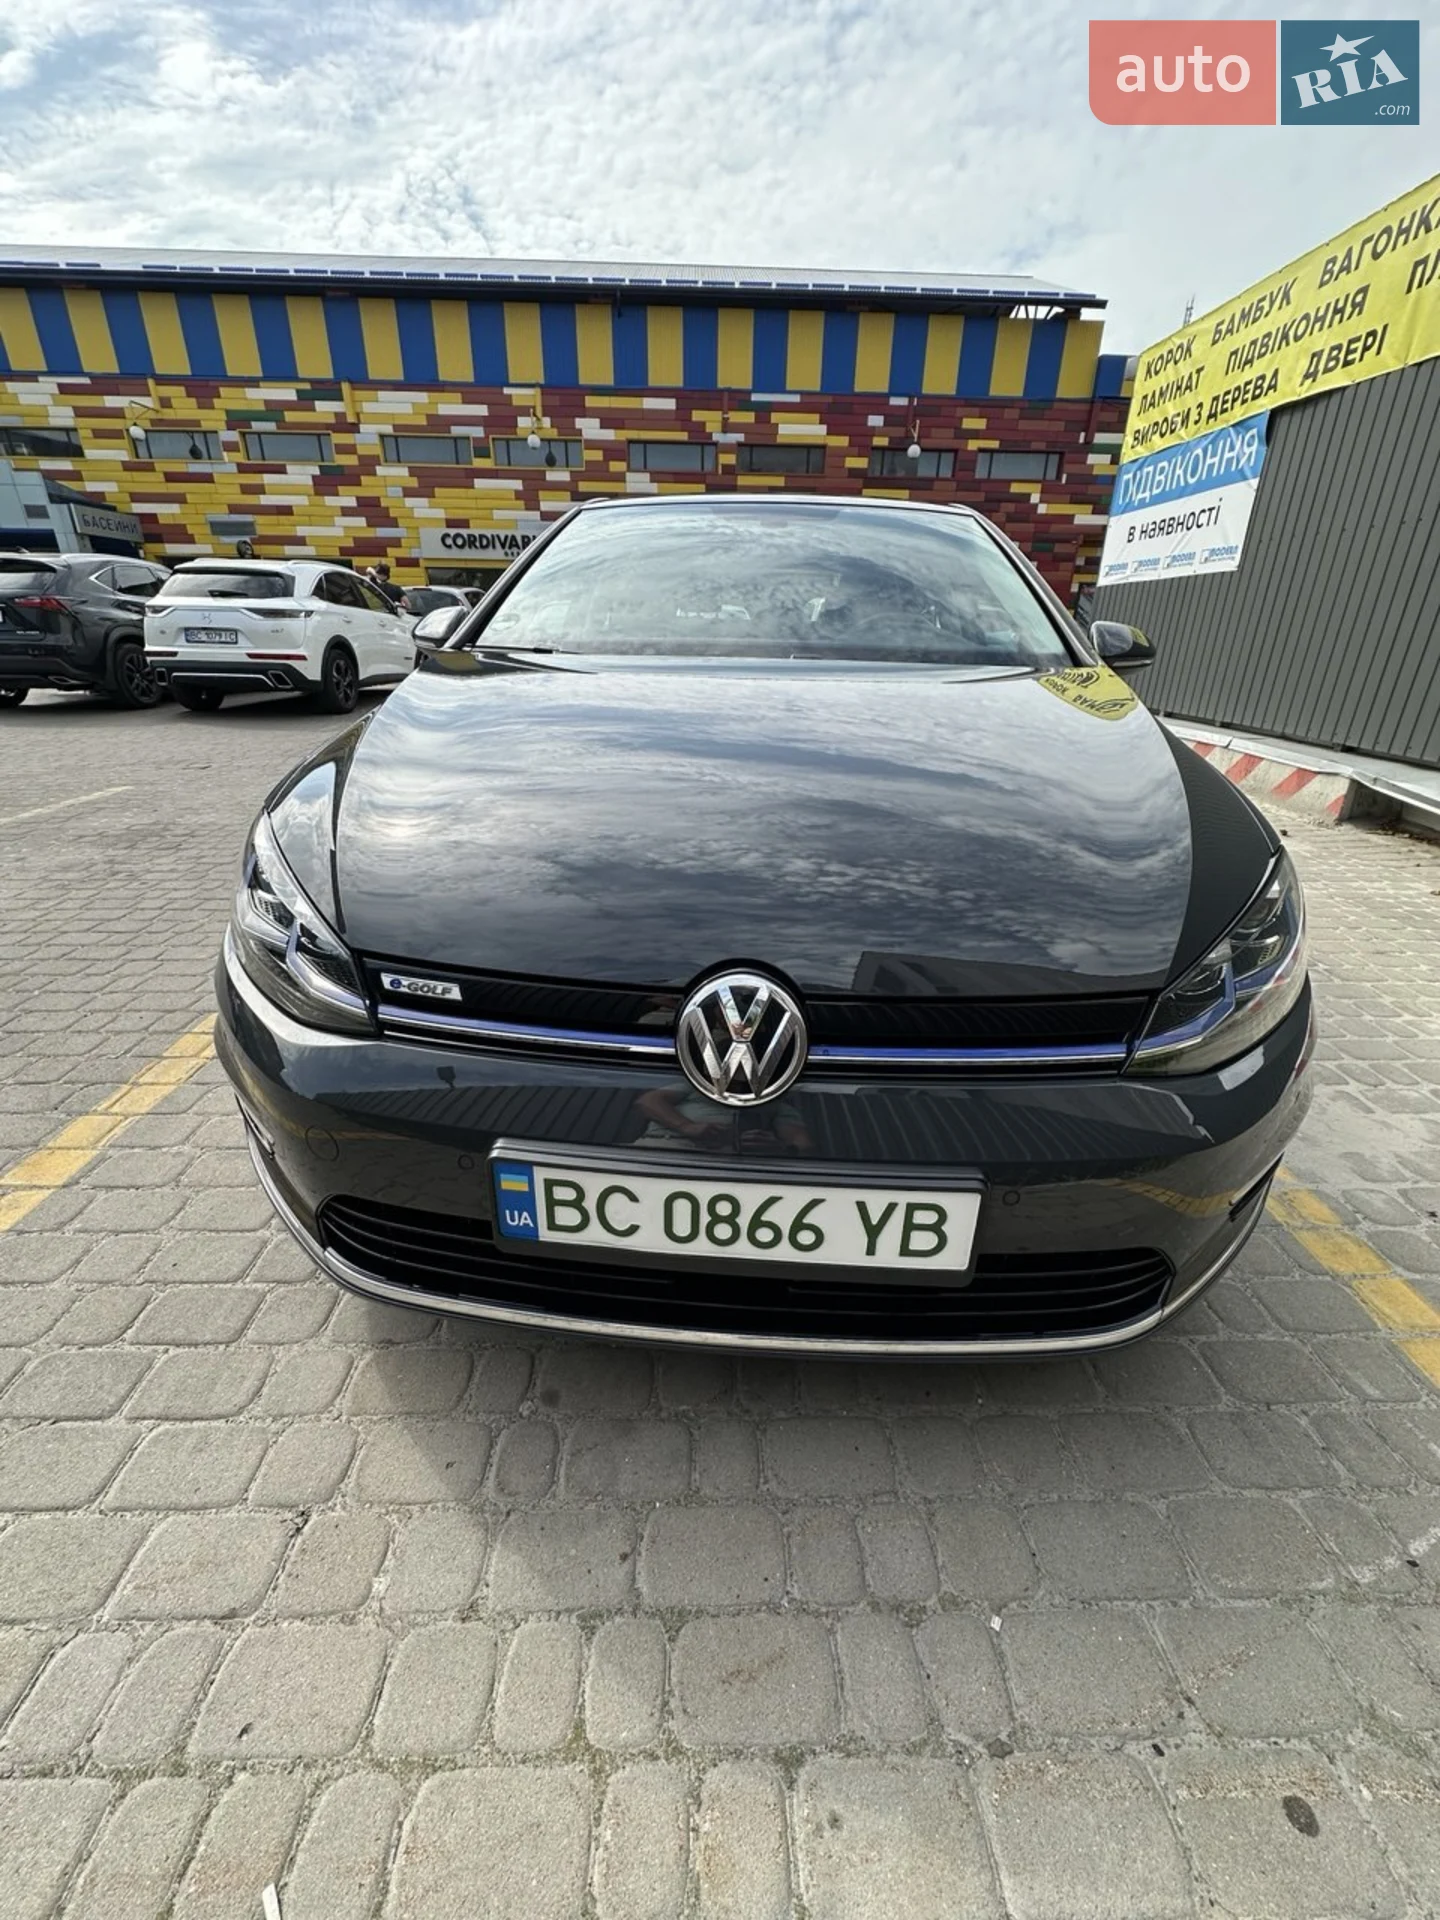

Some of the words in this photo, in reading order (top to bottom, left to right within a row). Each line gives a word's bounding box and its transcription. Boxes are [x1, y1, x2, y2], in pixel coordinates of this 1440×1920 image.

[1144, 334, 1197, 382] КОРОК
[1211, 276, 1298, 347] БАМБУК
[1318, 197, 1440, 290] ВАГОНК
[1131, 407, 1191, 449] ВИРОБИ
[1206, 368, 1279, 425] ДЕРЕВА
[1299, 323, 1389, 387] ДВЕРІ
[1137, 366, 1205, 416] ЛАМІНАТ
[1225, 284, 1371, 376] ПІДВІКОННЯ
[1118, 427, 1258, 506] ПІДВІКОННЯ
[440, 532, 540, 551] CORDIVAR
[1138, 497, 1223, 540] наявності
[389, 978, 453, 997] e-GOLF
[505, 1208, 534, 1228] UA
[543, 1178, 640, 1237] BC
[663, 1190, 827, 1252] 0866
[855, 1201, 948, 1257] YB
